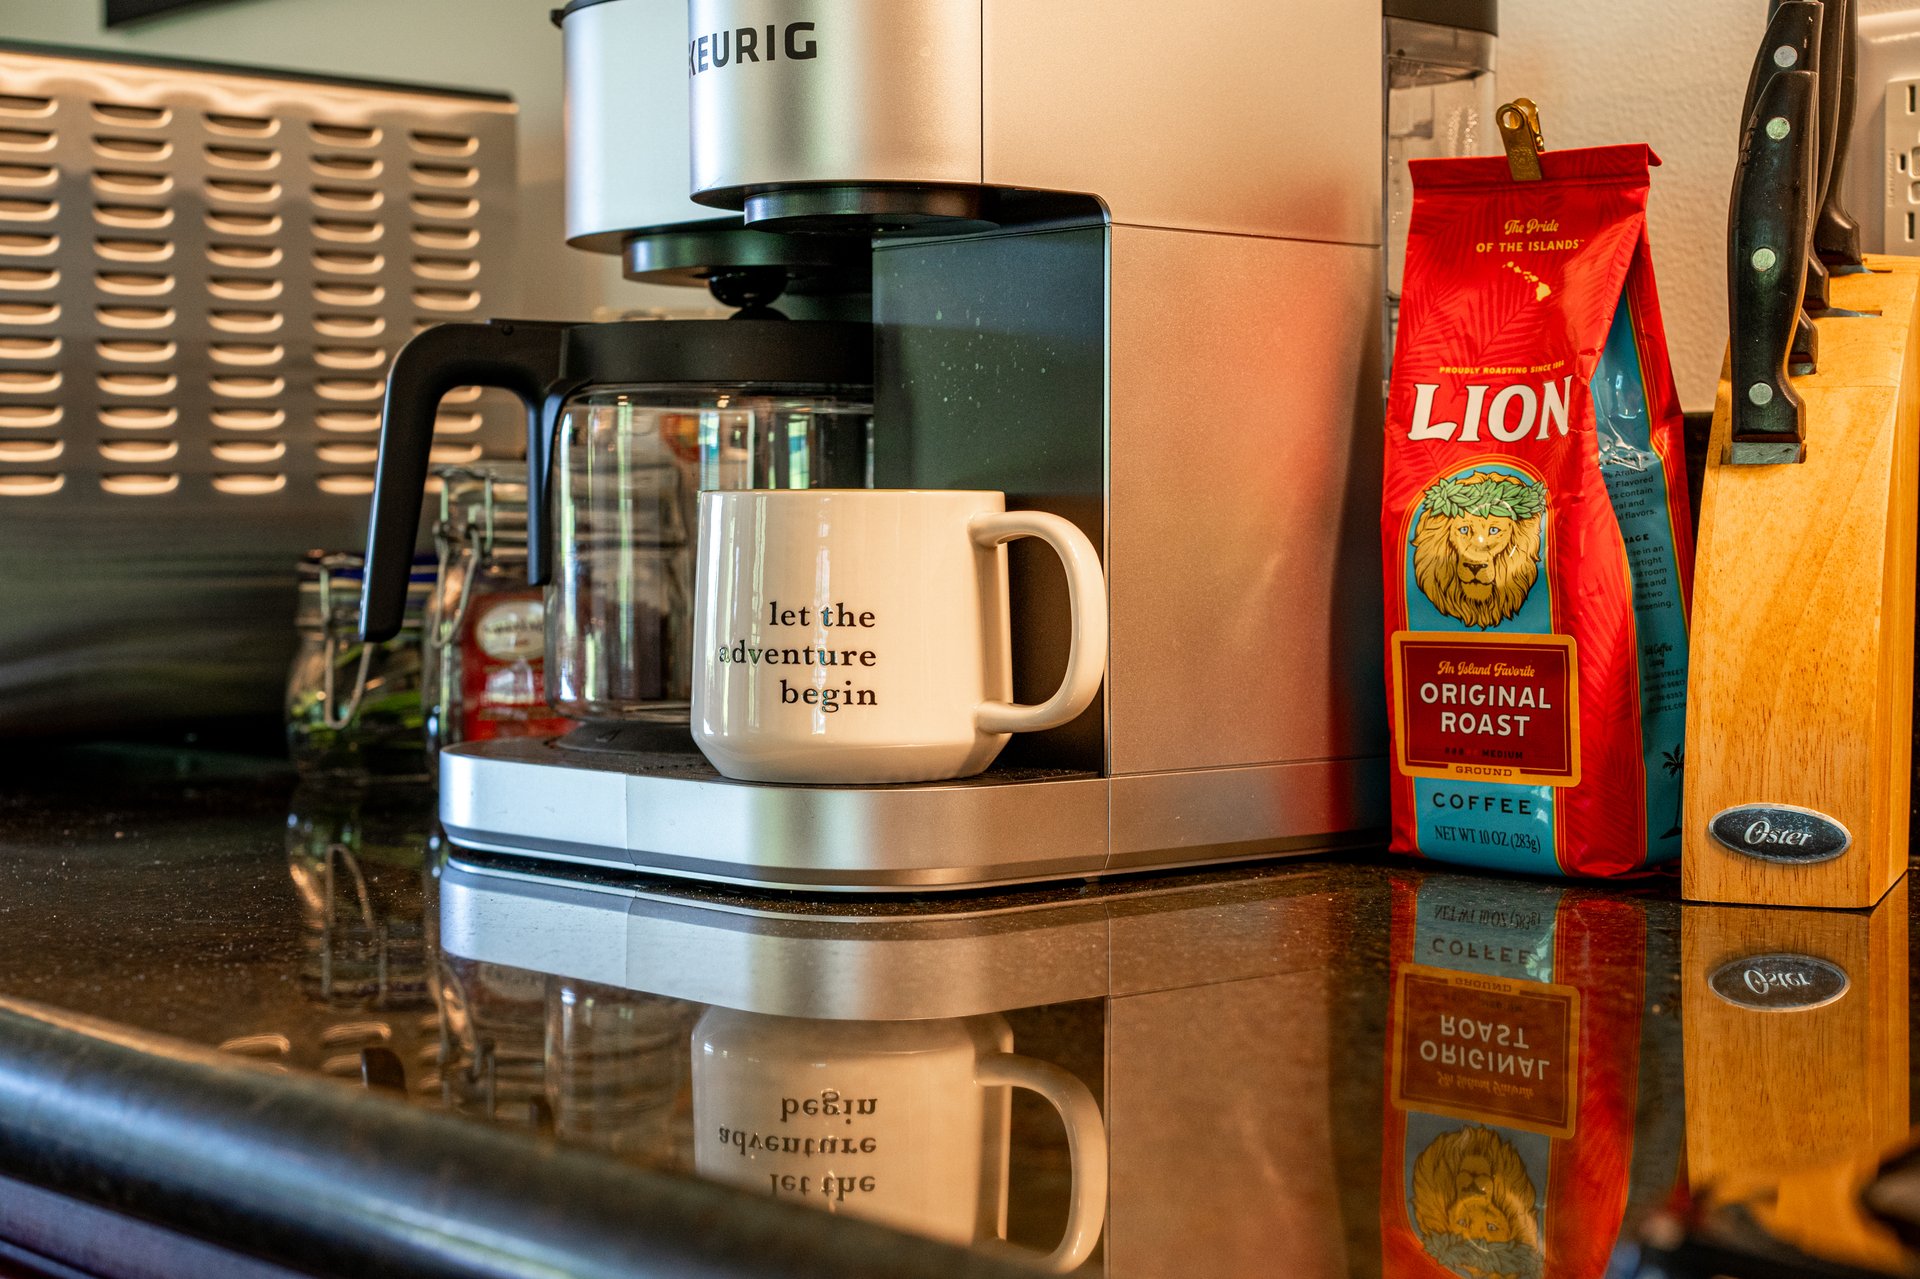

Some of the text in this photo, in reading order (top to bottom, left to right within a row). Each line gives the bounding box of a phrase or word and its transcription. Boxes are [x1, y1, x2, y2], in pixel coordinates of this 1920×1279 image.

[689, 21, 817, 78] KEURIG
[1504, 218, 1559, 235] The Pride
[1476, 242, 1494, 253] OF
[1499, 242, 1523, 252] THE
[1440, 366, 1480, 374] PROUDLY
[1483, 366, 1527, 374] ROASTING
[1530, 363, 1551, 373] SINCE
[1407, 375, 1573, 442] LION
[1615, 475, 1654, 488] Flavored
[1620, 488, 1653, 498] contain
[1628, 499, 1645, 507] and
[769, 601, 875, 627] let the
[719, 640, 876, 666] adventure
[1437, 661, 1535, 677] An Island Favorite
[780, 679, 878, 713] begin
[1420, 682, 1552, 709] ORIGINAL
[1441, 711, 1530, 737] ROAST
[1482, 750, 1523, 760] MEDIUM
[1455, 765, 1513, 777] GROUND
[1432, 792, 1532, 815] COFFEE
[1435, 825, 1541, 855] NET WT 10 OZ (283g)
[1744, 820, 1812, 846] Oster
